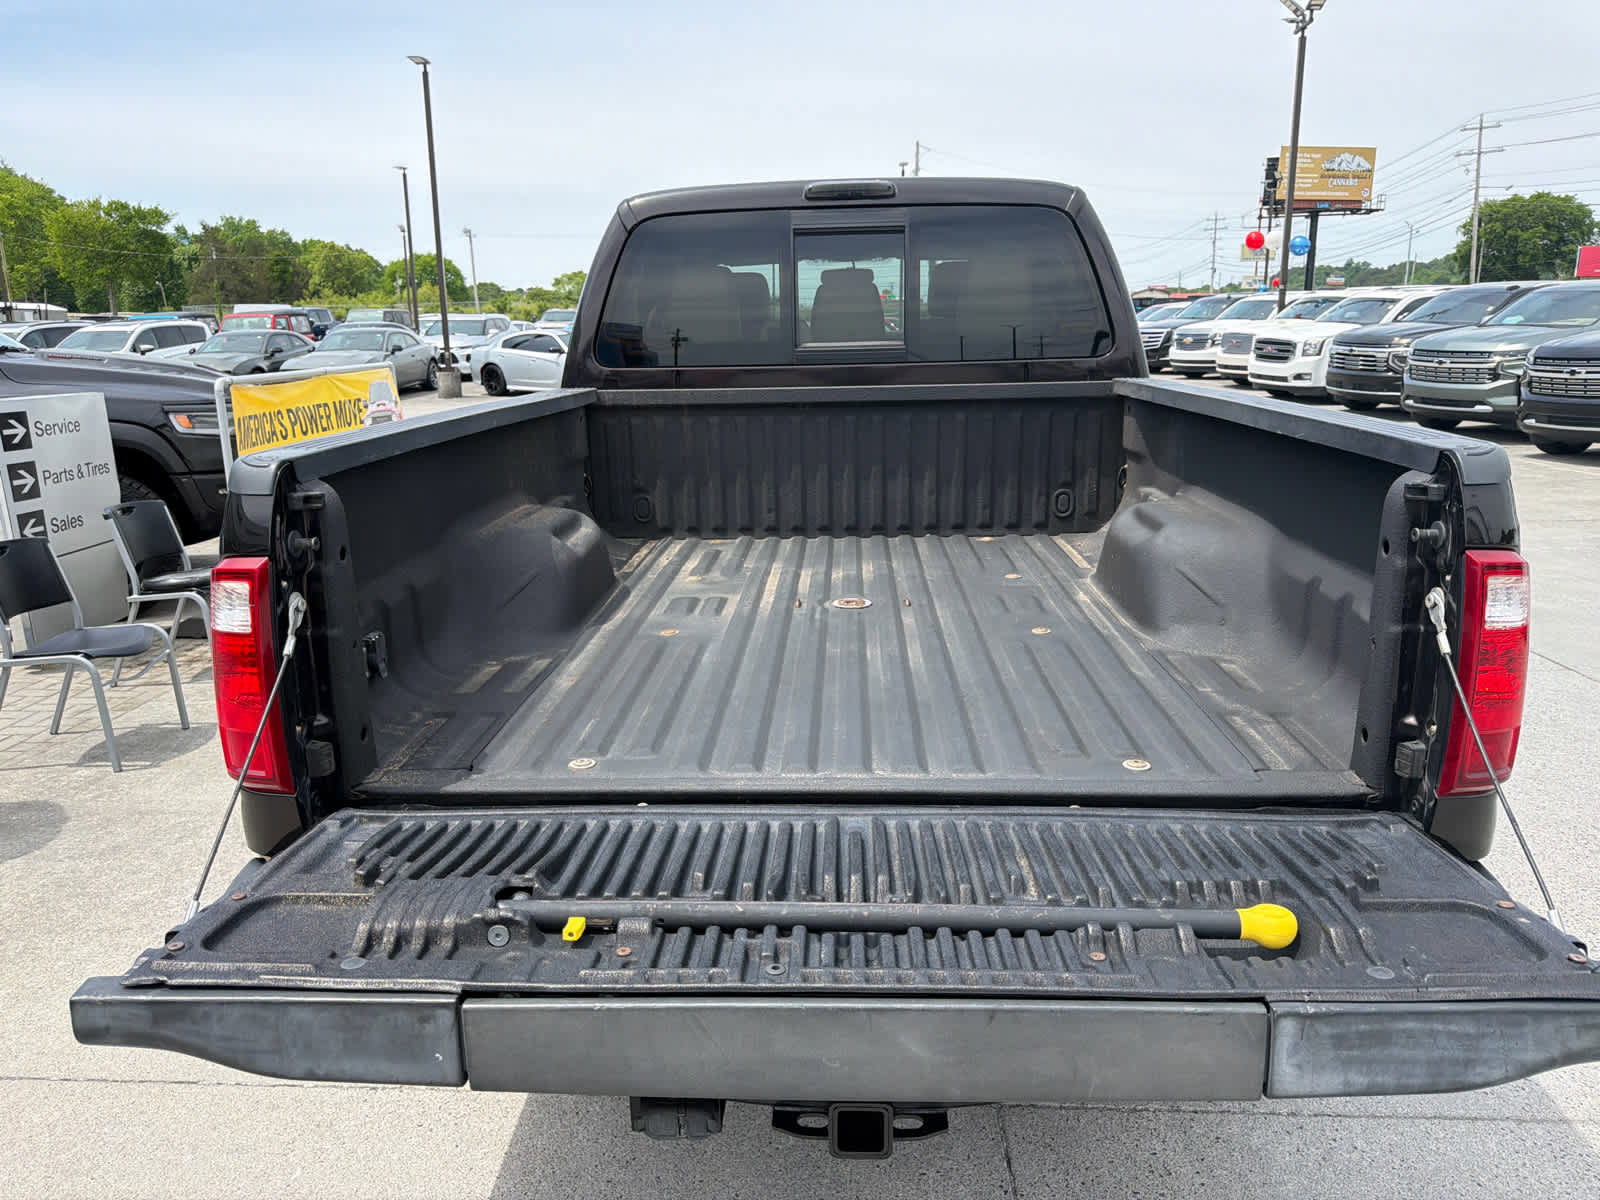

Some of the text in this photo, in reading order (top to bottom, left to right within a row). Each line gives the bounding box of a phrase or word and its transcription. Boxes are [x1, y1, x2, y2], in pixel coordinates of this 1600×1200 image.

[33, 418, 80, 437] Service
[237, 409, 289, 452] AMERICA'S
[286, 402, 334, 438] POWER
[42, 461, 110, 486] Parts & Tires
[50, 514, 84, 534] Sales
